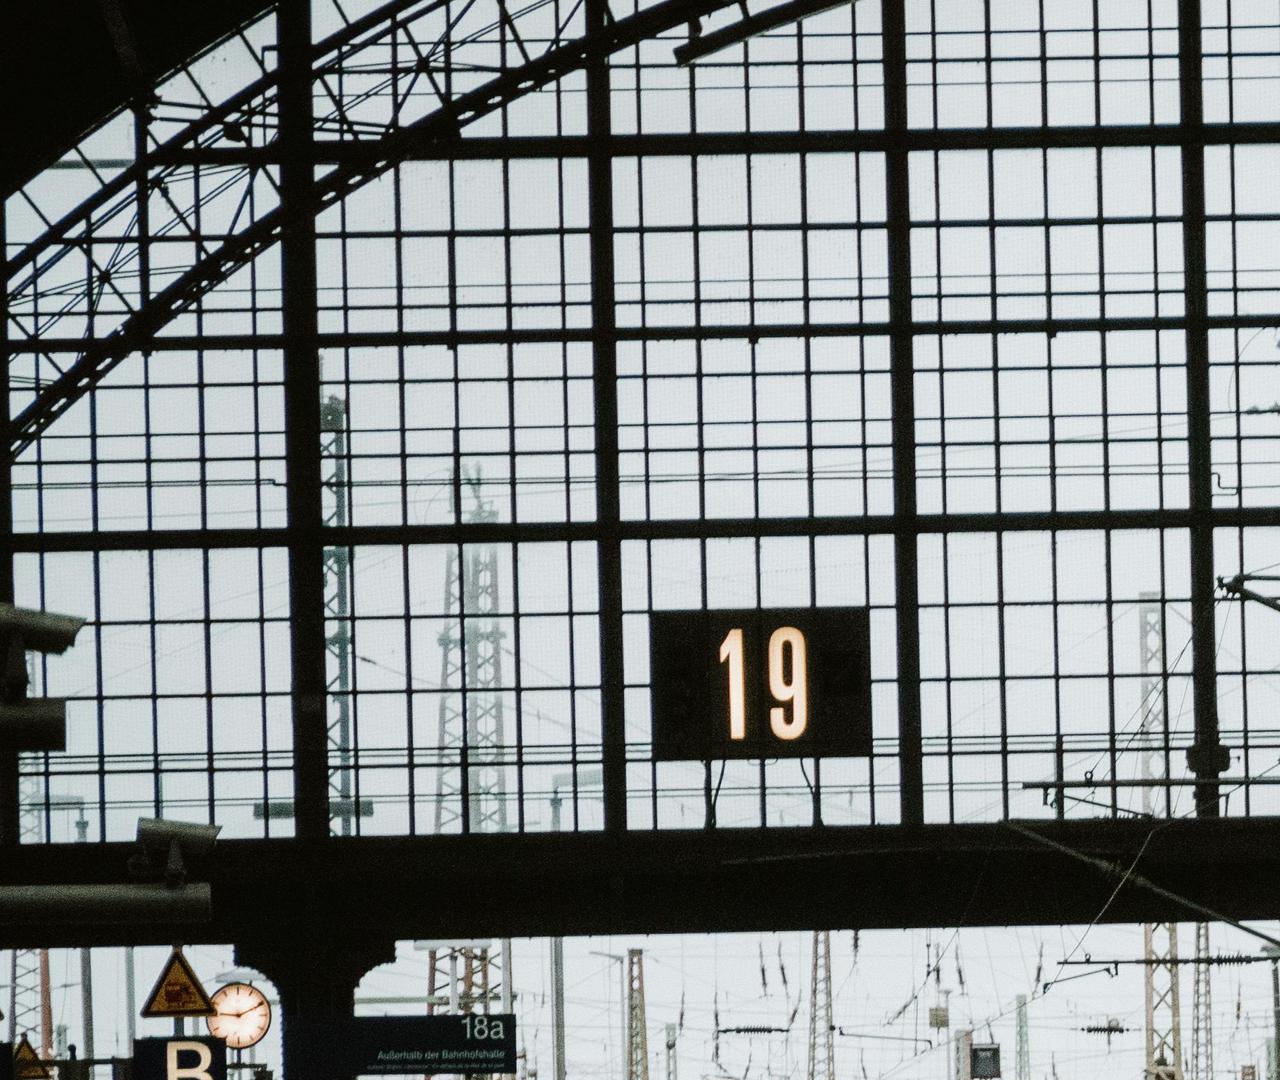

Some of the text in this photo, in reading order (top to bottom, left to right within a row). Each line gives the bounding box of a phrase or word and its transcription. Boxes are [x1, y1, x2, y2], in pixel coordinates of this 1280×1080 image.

[718, 626, 809, 741] 19
[461, 1016, 505, 1040] 18a
[424, 1050, 439, 1060] der
[442, 1049, 505, 1060] Bahnhofshalle
